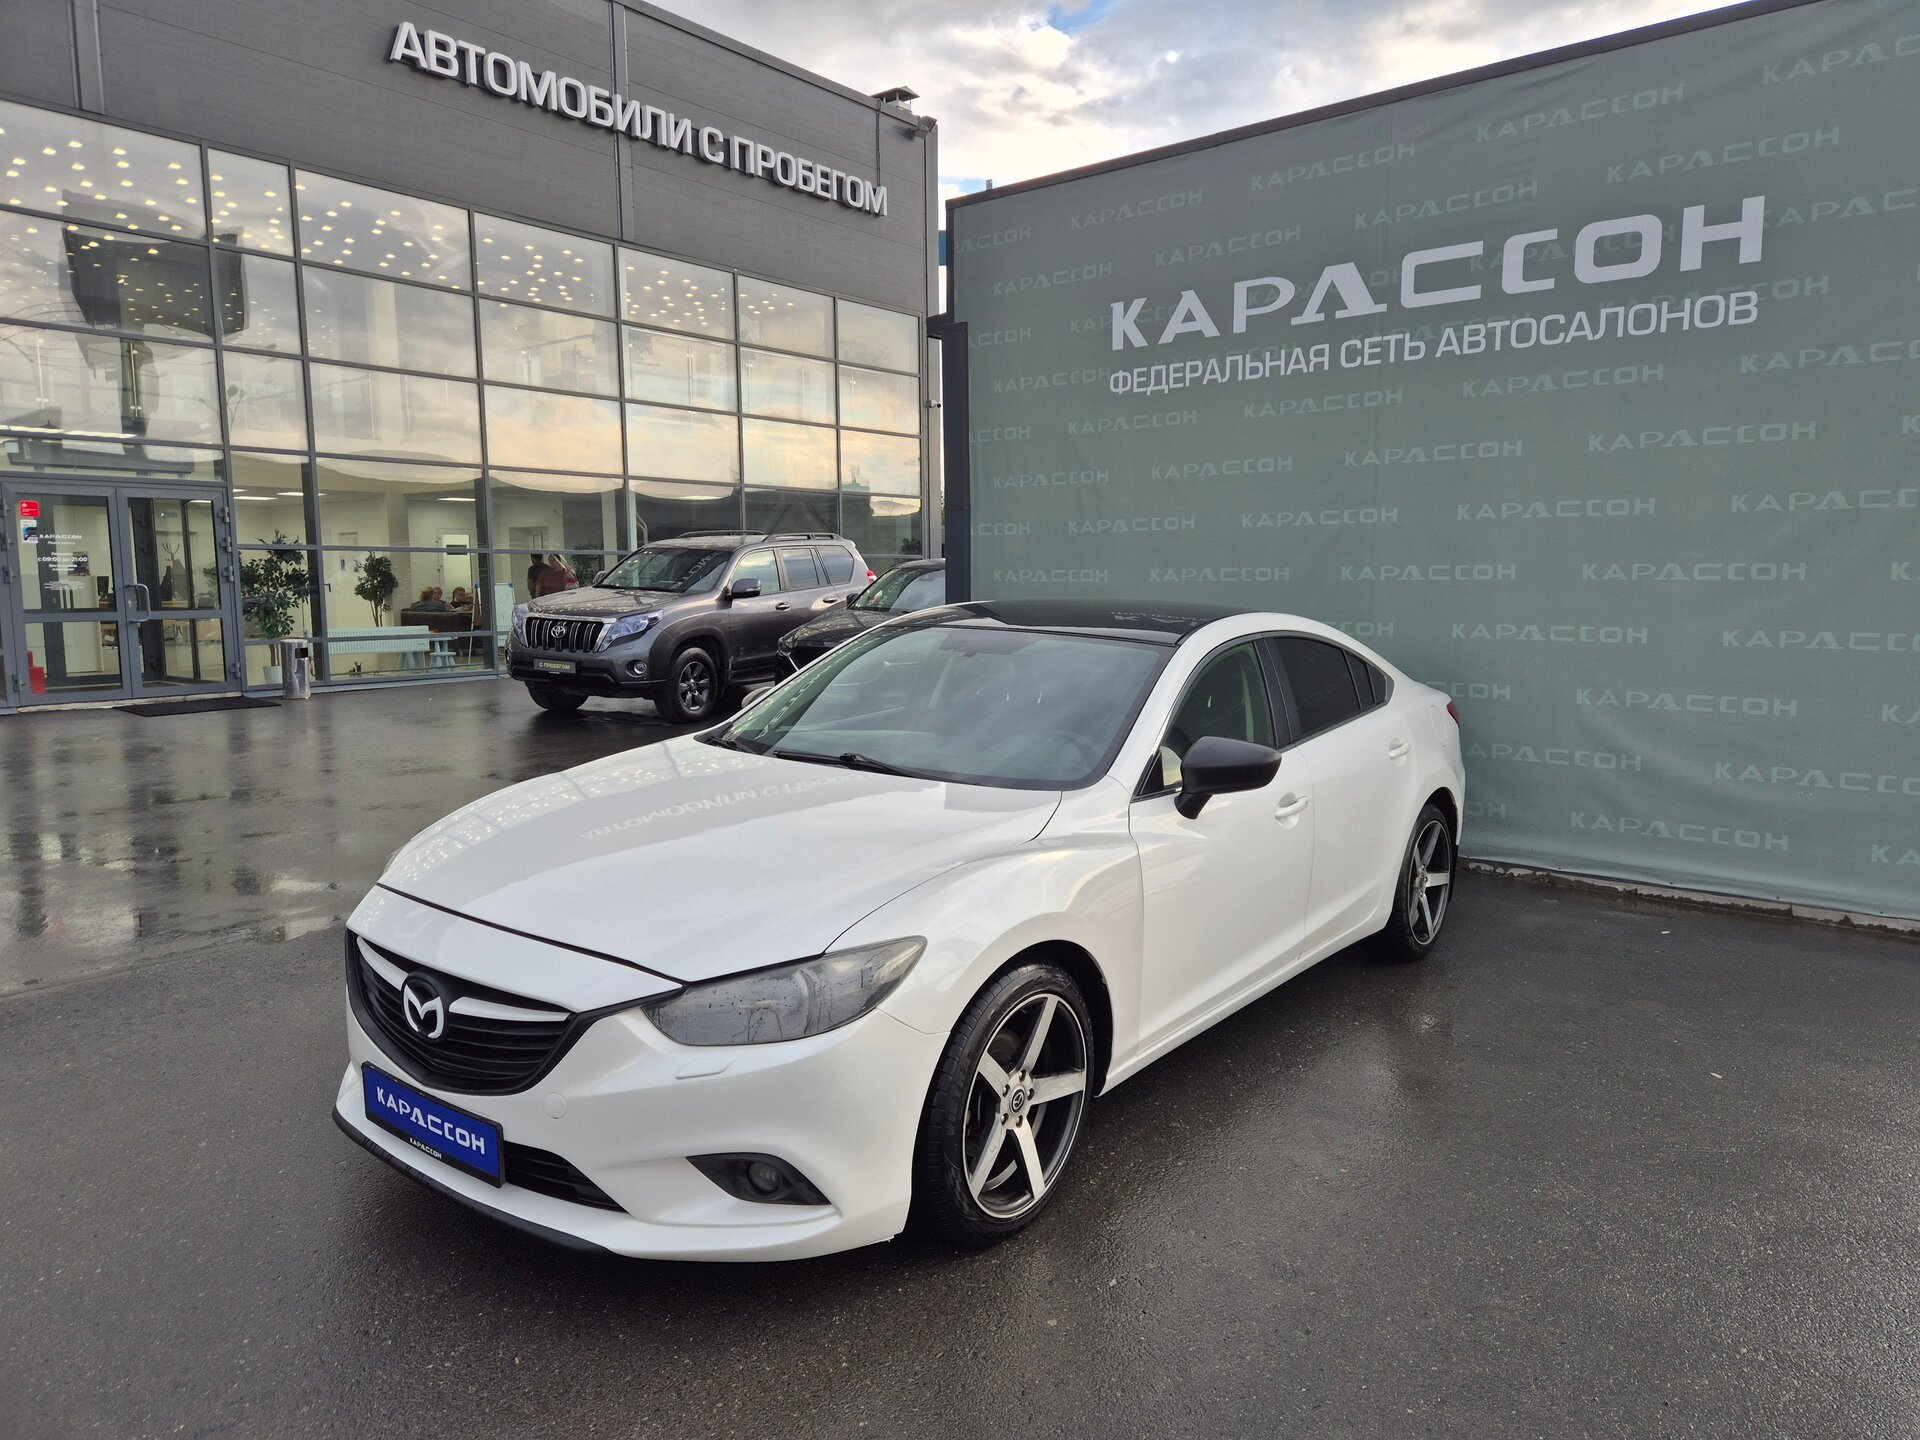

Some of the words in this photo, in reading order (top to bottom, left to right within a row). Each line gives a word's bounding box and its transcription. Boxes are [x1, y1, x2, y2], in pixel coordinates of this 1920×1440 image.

[390, 21, 692, 154] АВТОМОБИЛИ
[699, 127, 725, 163] С
[729, 135, 889, 217] ПРОБЕГОМ
[1477, 83, 1685, 143] КАРАССОН
[1251, 143, 1416, 191] КАРАССОН
[1607, 125, 1840, 184] КАРАССОН
[1071, 188, 1203, 230] КАРАССОН
[1355, 180, 1538, 230] КАРАССОН
[1155, 225, 1301, 267] КАРАССОН
[993, 262, 1113, 296] КАРАССОН
[1110, 195, 1766, 351] КАРАССОН
[1109, 342, 1330, 396] ФЕДЕРАЛЬНАЯ
[1340, 332, 1426, 369] СЕТЬ
[1435, 290, 1759, 358] АВТОСАЛОНОВ
[1462, 363, 1665, 398] КАРАССОН
[1244, 389, 1404, 419] КАРАССОН
[1068, 410, 1198, 436] КАРАССОН
[1589, 421, 1817, 452] КАРАССОН
[1151, 456, 1293, 480] КАРАССОН
[1345, 439, 1523, 467] КАРАССОН
[993, 470, 1109, 488] КАРАССОН
[1068, 515, 1196, 534] КАРАССОН
[1242, 507, 1399, 528] КАРАССОН
[1456, 498, 1656, 521] КАРАССОН
[994, 569, 1109, 582] КАРАССОН
[1150, 566, 1290, 582] КАРАССОН
[1341, 563, 1516, 581] КАРАССОН
[1582, 562, 1806, 581] КАРАССОН
[1452, 624, 1648, 645] КАРАССОН
[1575, 688, 1797, 718] КАРАССОН
[1570, 812, 1788, 852] КАРАССОН
[376, 1085, 486, 1155] КАРАССОН
[409, 1136, 442, 1160] КАРАССОН
